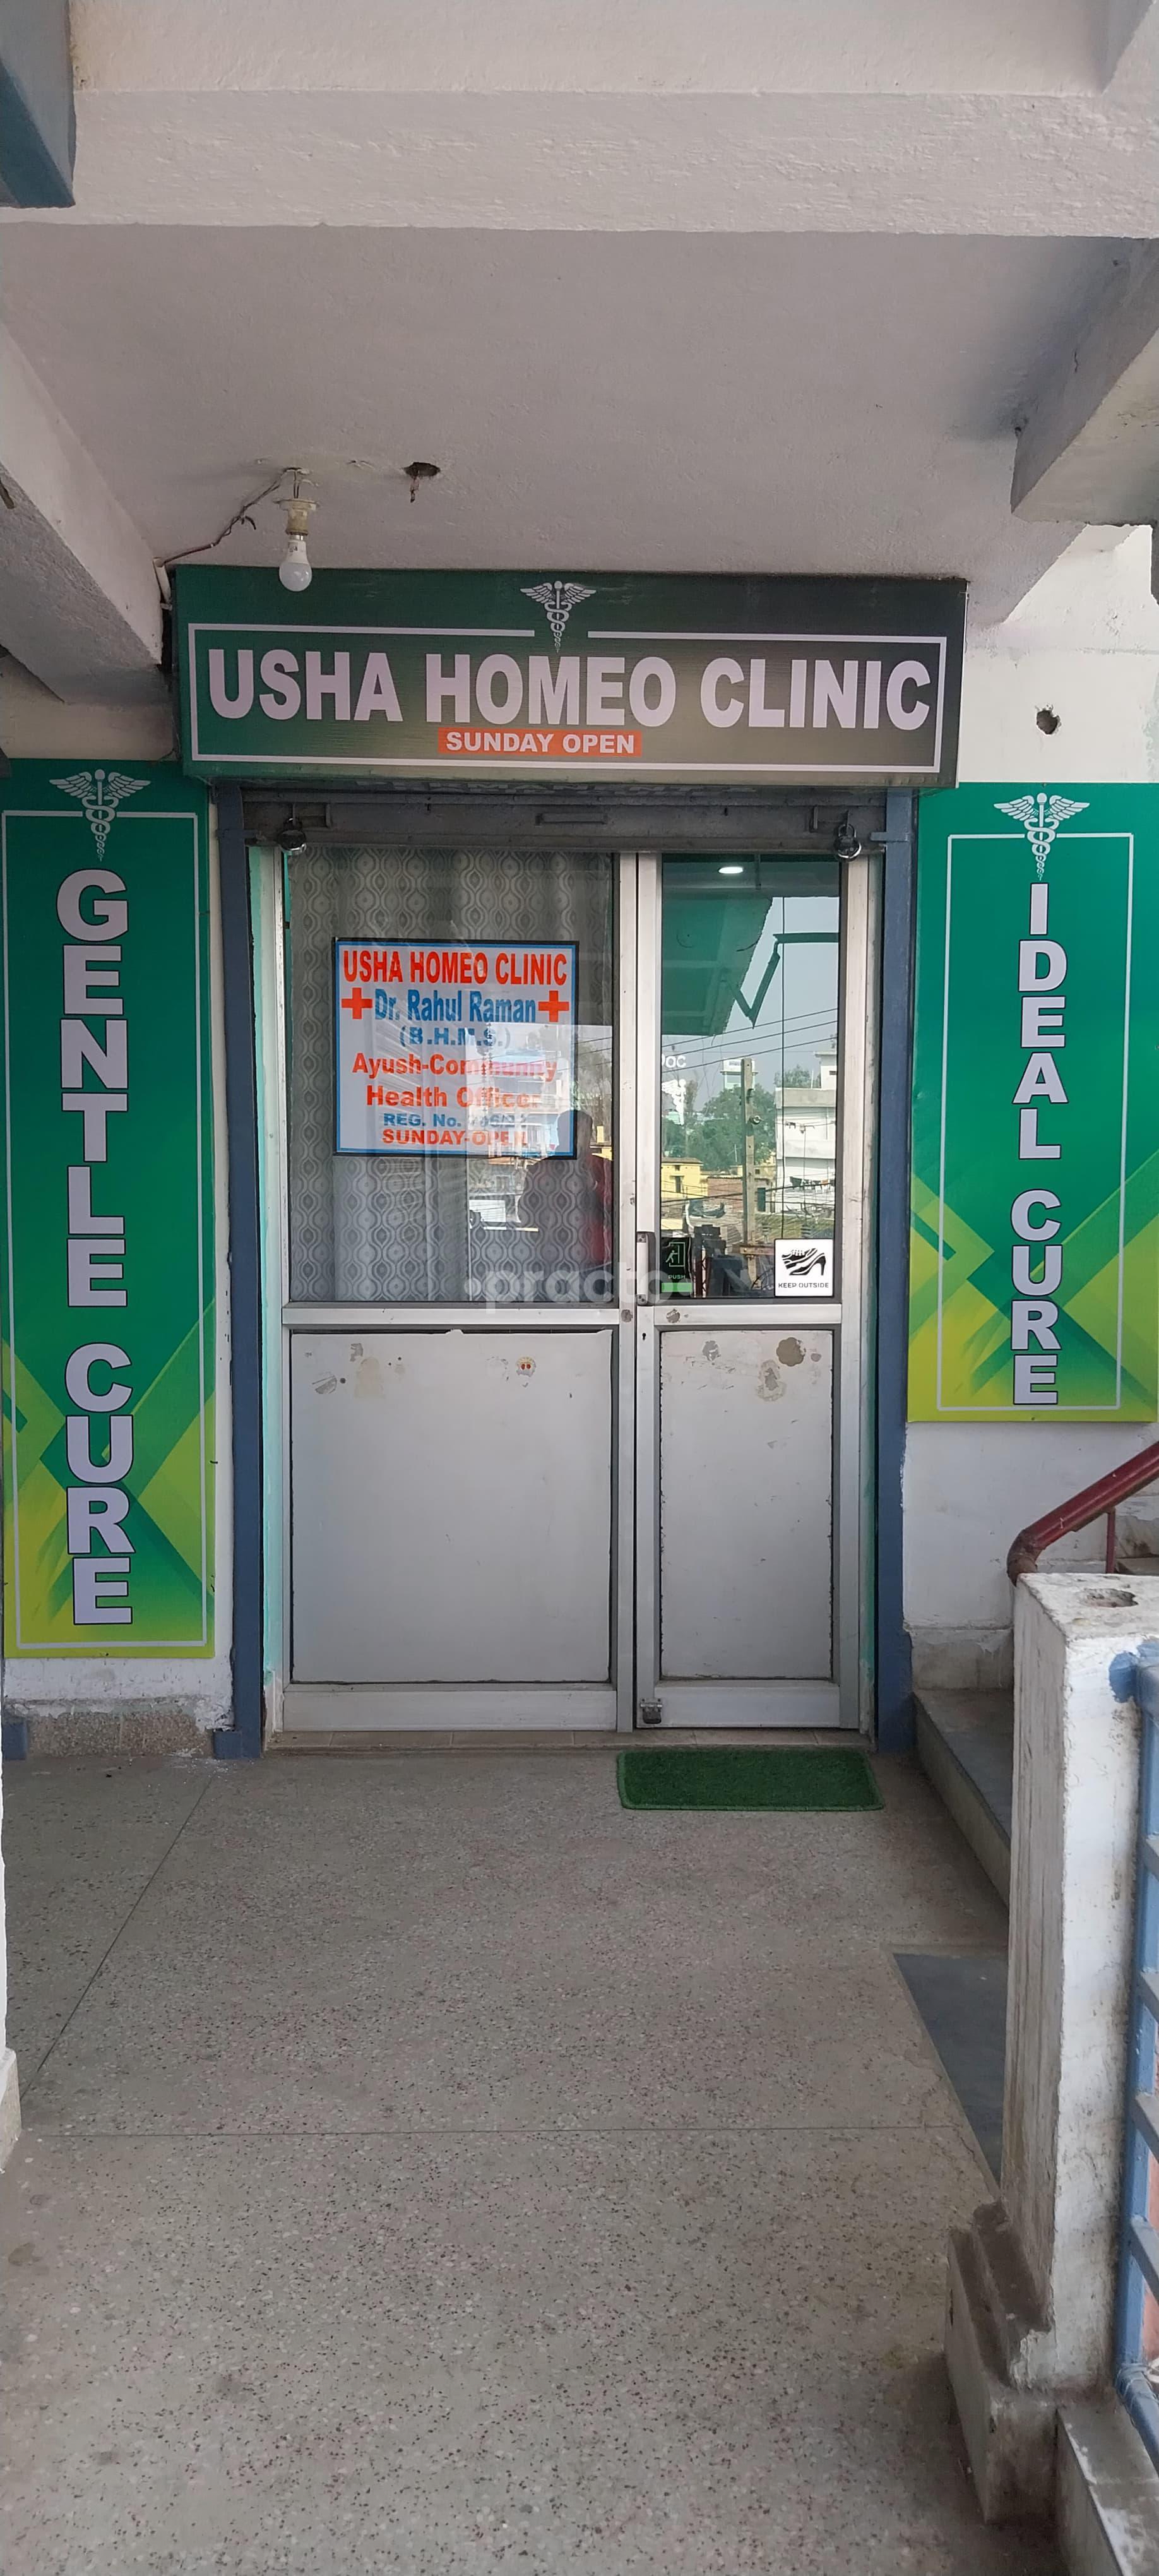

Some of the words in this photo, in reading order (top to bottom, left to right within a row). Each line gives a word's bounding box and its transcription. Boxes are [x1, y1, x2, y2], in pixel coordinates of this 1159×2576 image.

[208, 648, 403, 722] USHA
[425, 655, 677, 727] HOMEO
[700, 657, 932, 731] CLINIC
[446, 732, 554, 754] SUNDAY
[562, 733, 635, 754] OPEN
[343, 950, 403, 983] USHA
[410, 951, 489, 985] HOMEO
[495, 953, 568, 986] CLINIC
[374, 988, 400, 1020] Dr.
[408, 989, 461, 1022] Rahul
[469, 991, 536, 1023] Raman
[1011, 881, 1069, 1160] IDEAL
[662, 1053, 686, 1068] oc
[56, 868, 129, 1308] GENTLE
[366, 1085, 448, 1107] Health
[456, 1086, 542, 1109] Officer
[384, 1113, 427, 1127] REG.
[434, 1114, 461, 1128] No.
[1010, 1189, 1062, 1405] CURE
[64, 1342, 136, 1626] CURE
